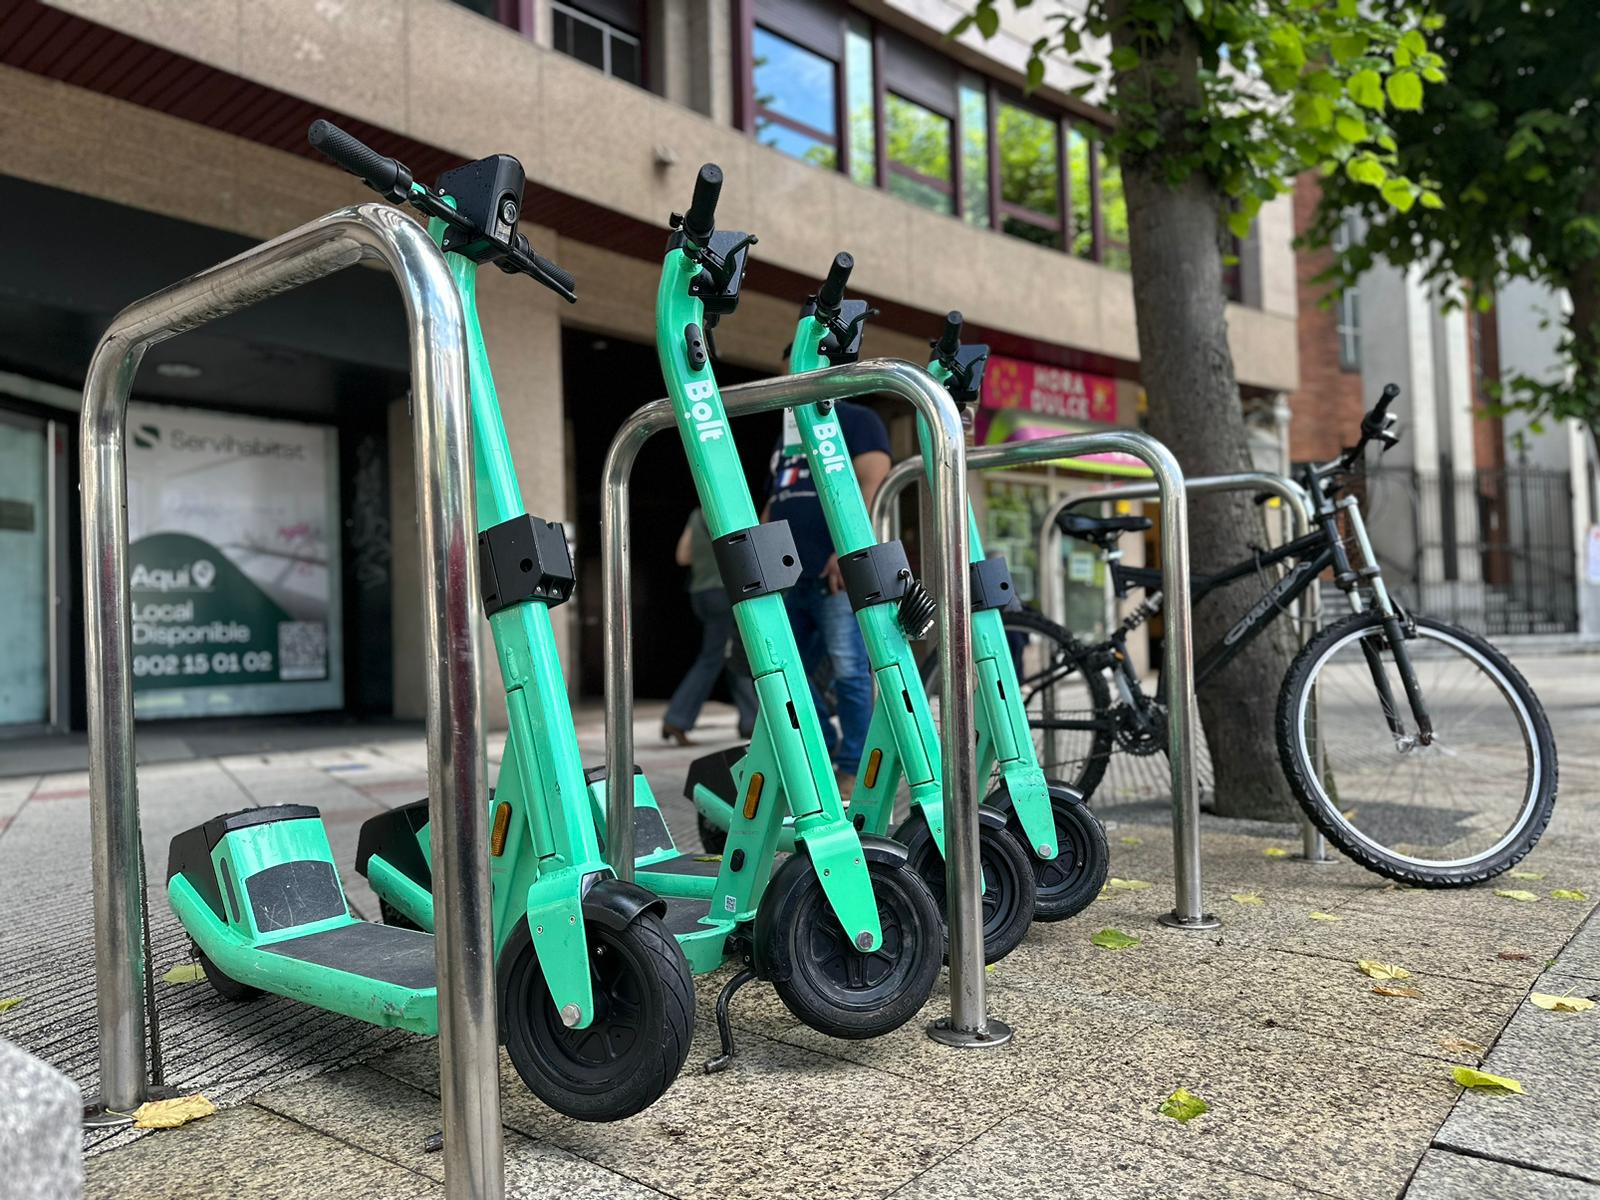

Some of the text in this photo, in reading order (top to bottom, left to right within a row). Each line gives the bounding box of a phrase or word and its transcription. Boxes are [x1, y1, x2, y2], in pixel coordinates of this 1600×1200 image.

[684, 380, 724, 443] Bolt
[812, 422, 847, 474] Bolt
[132, 600, 194, 622] Local
[132, 621, 251, 647] Disponible
[211, 652, 241, 674] 01
[242, 650, 273, 672] 02
